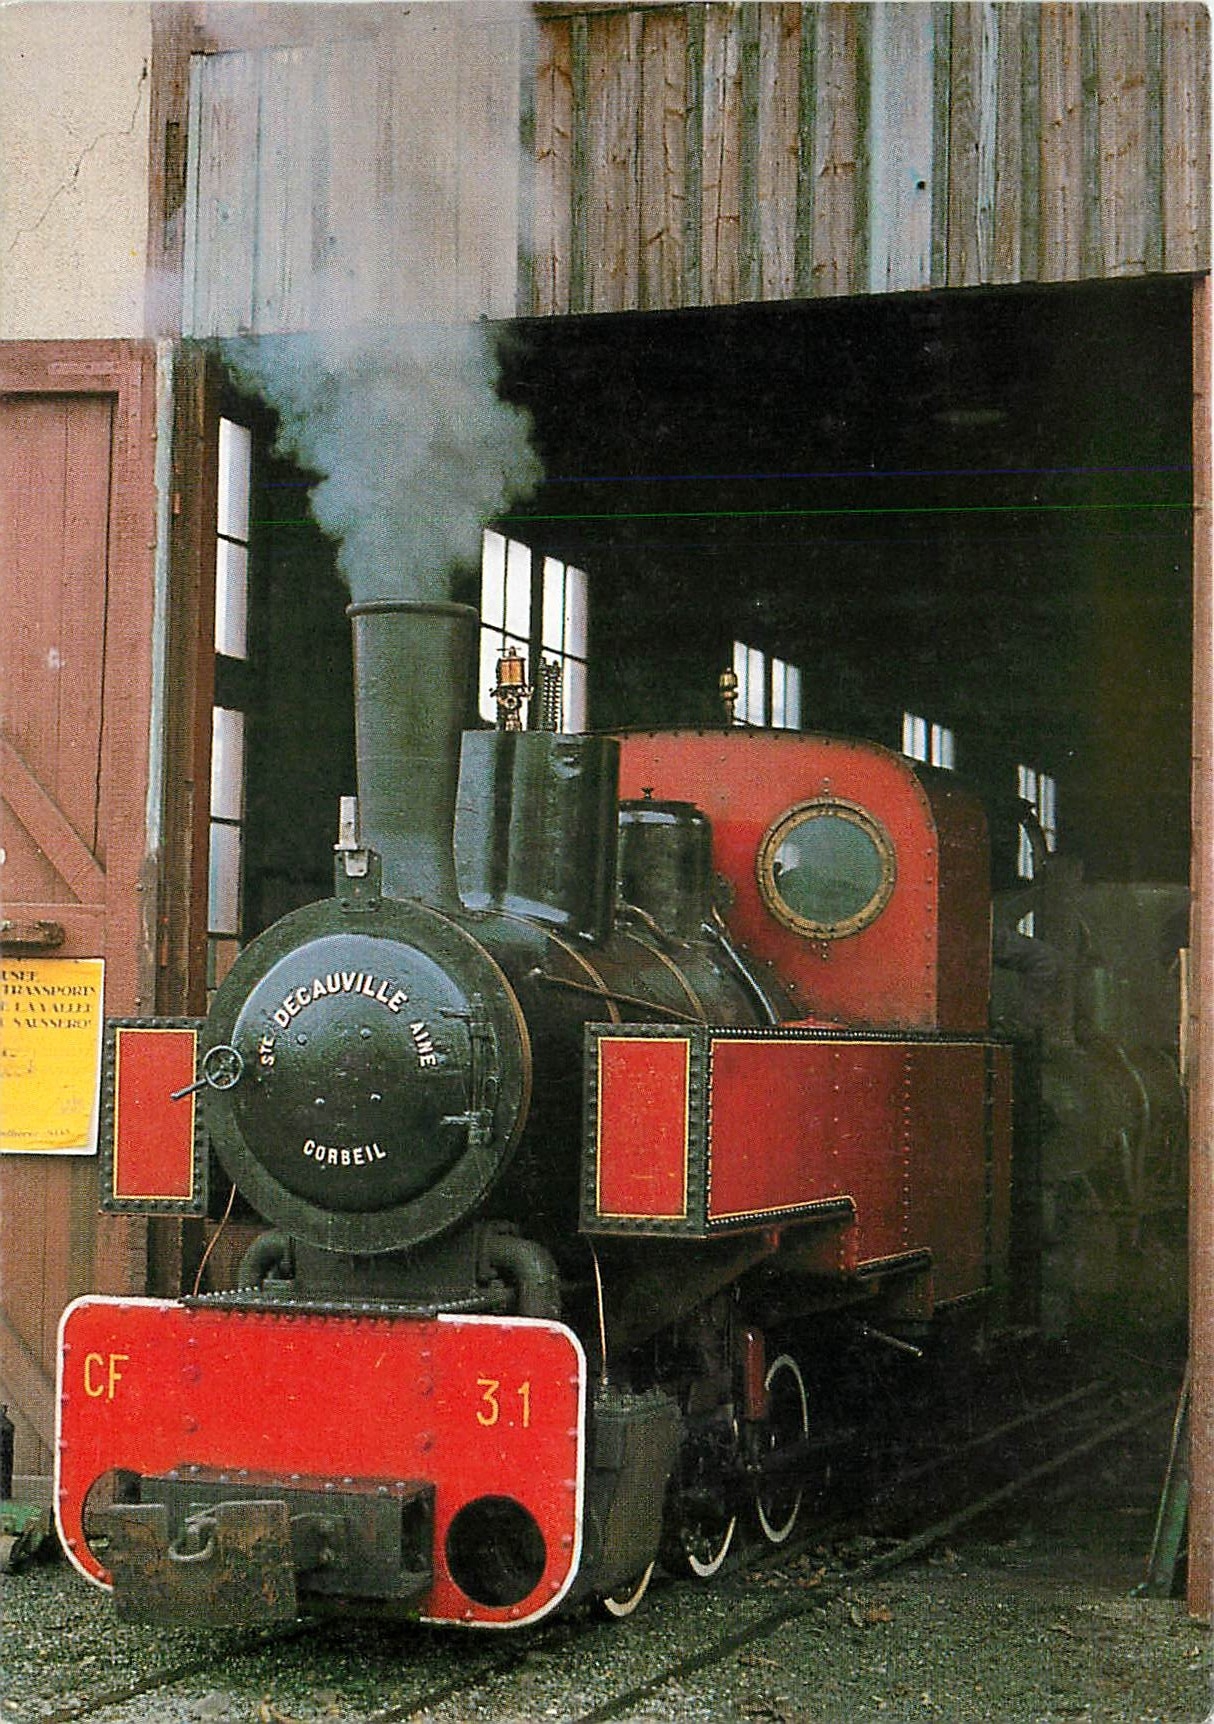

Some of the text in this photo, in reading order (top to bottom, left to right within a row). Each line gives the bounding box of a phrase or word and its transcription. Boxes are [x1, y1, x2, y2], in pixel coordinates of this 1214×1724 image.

[273, 971, 408, 1028] DECAUVILLE
[409, 1020, 437, 1067] AINE
[303, 1139, 387, 1166] CORBEIL
[83, 1348, 130, 1400] CF
